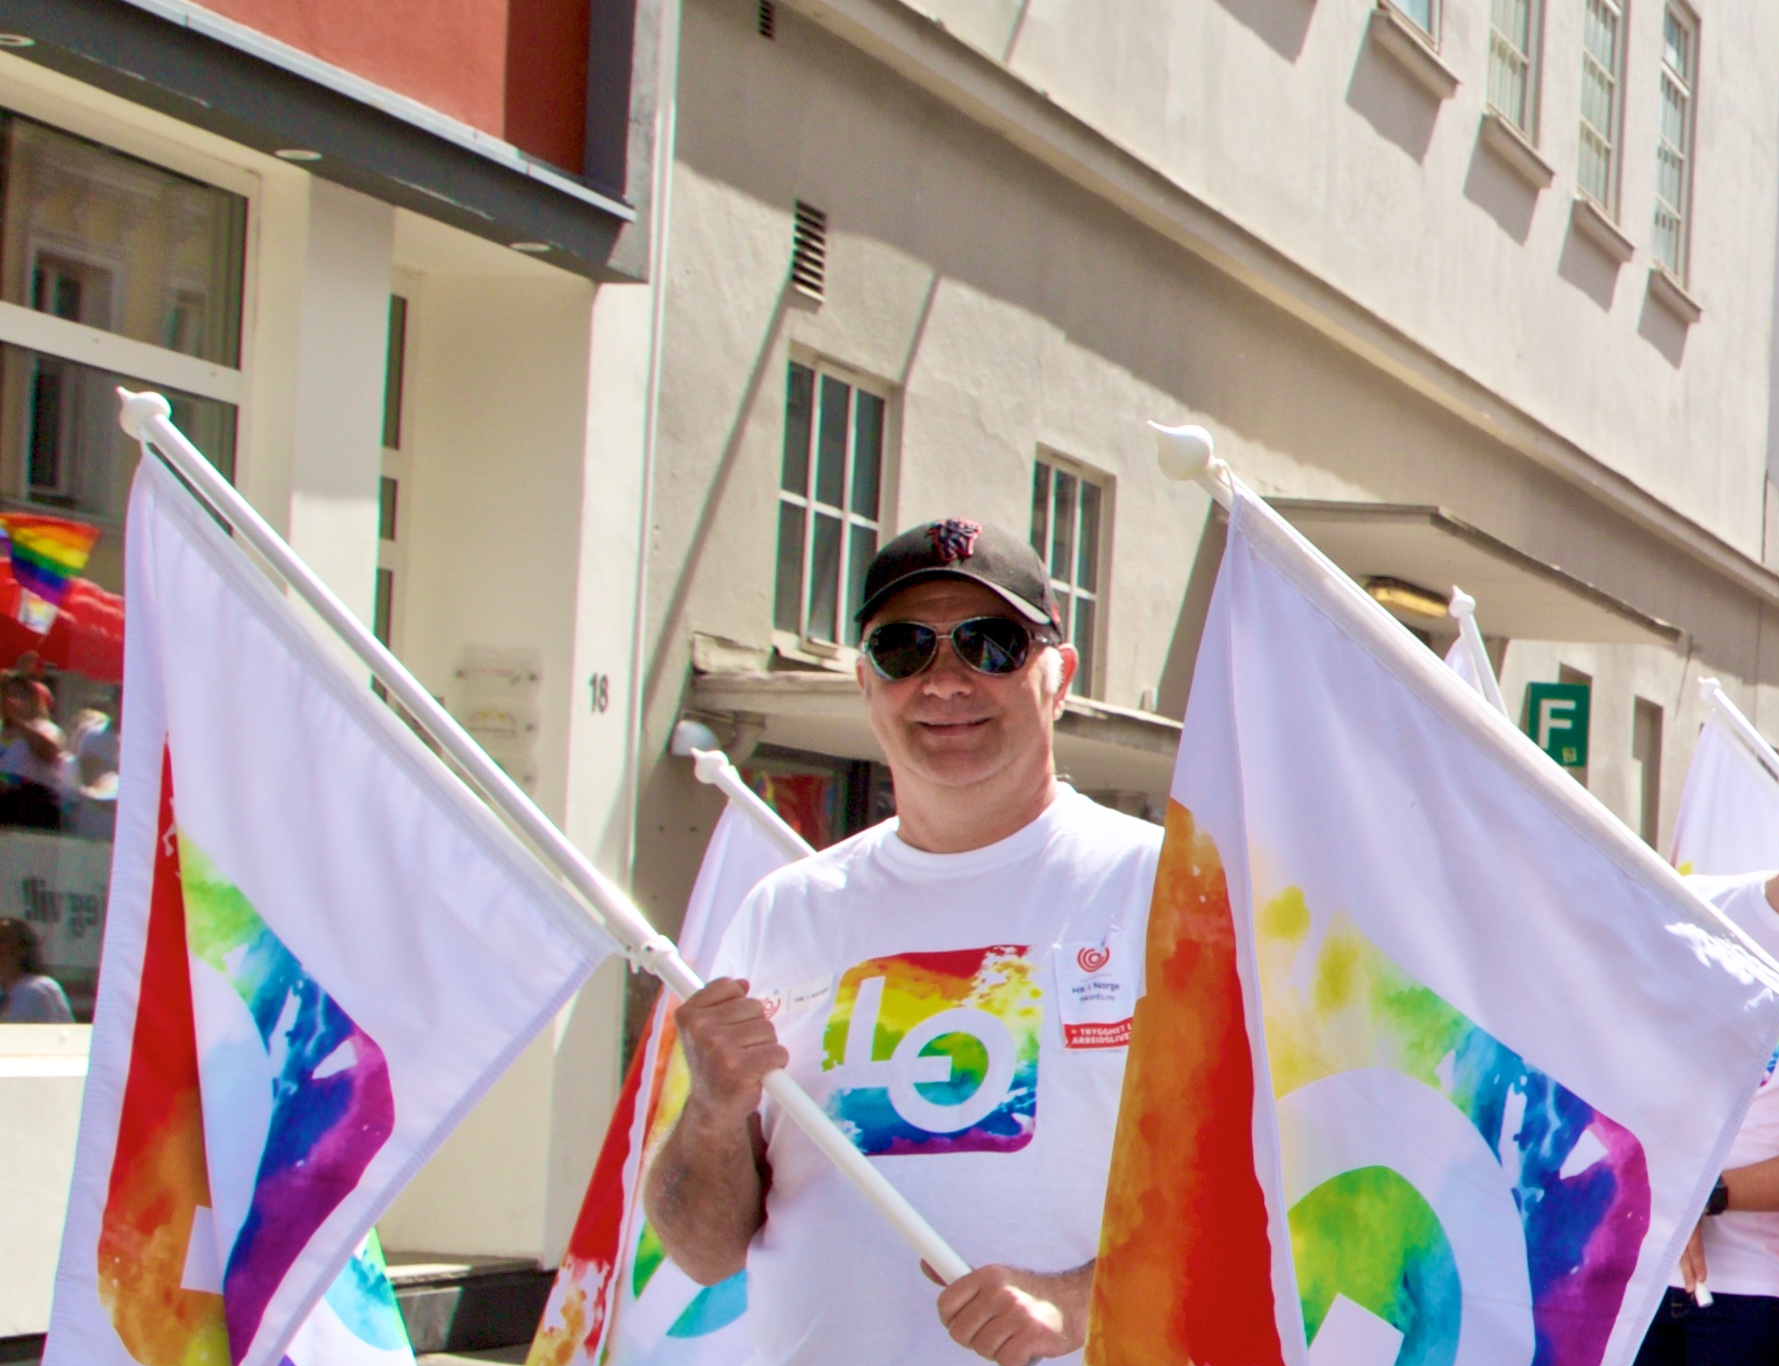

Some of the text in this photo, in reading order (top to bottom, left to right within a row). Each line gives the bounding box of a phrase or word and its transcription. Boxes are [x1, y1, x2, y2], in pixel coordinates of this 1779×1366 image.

[588, 673, 610, 714] 18
[1538, 699, 1576, 750] F
[1093, 981, 1120, 992] Norge
[1072, 1031, 1131, 1044] ARBEIDSLIVE
